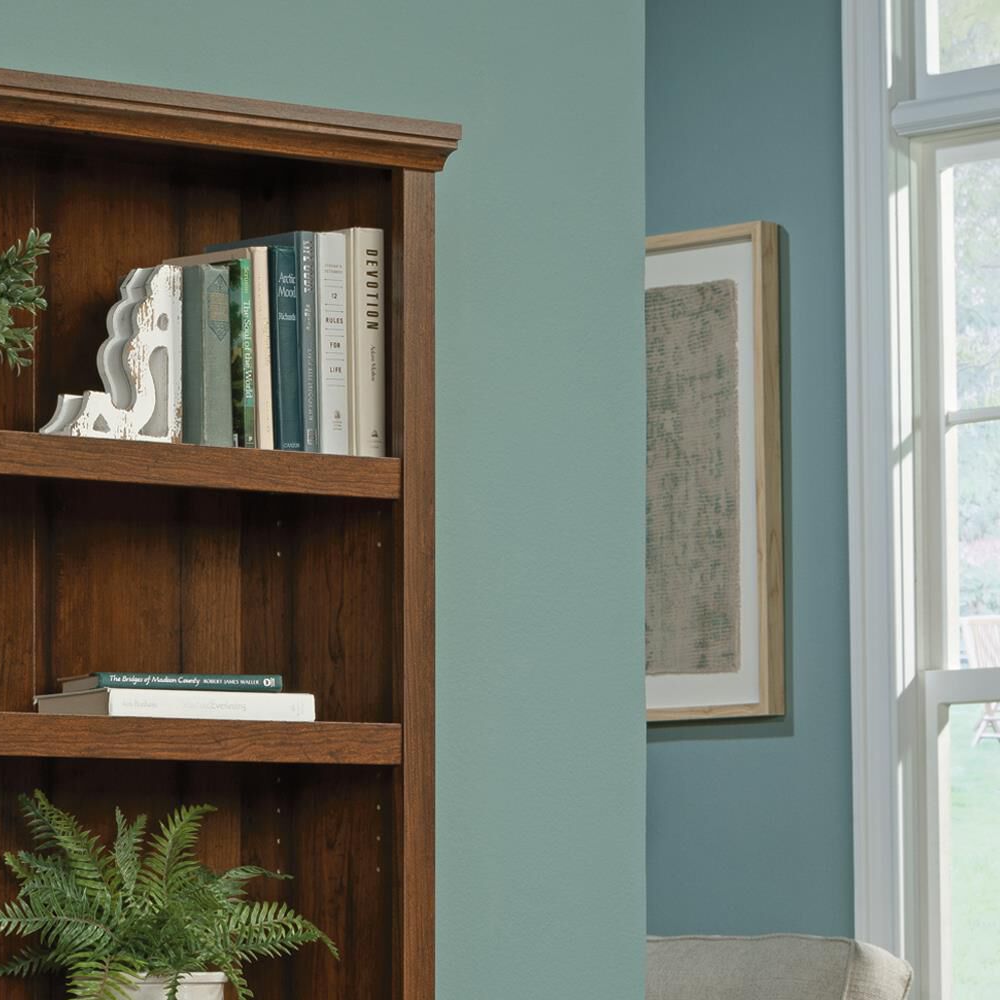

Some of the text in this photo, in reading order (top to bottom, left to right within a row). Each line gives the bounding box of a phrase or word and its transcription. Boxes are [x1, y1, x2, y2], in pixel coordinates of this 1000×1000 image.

[366, 249, 379, 330] DEVOTION
[243, 300, 251, 318] The
[243, 318, 252, 340] Soul
[325, 317, 344, 325] RULES
[244, 340, 252, 350] of
[244, 352, 253, 369] the
[244, 369, 253, 399] World
[121, 676, 143, 685] Bridges
[143, 676, 151, 685] of
[151, 676, 177, 684] Madison
[177, 677, 201, 686] County
